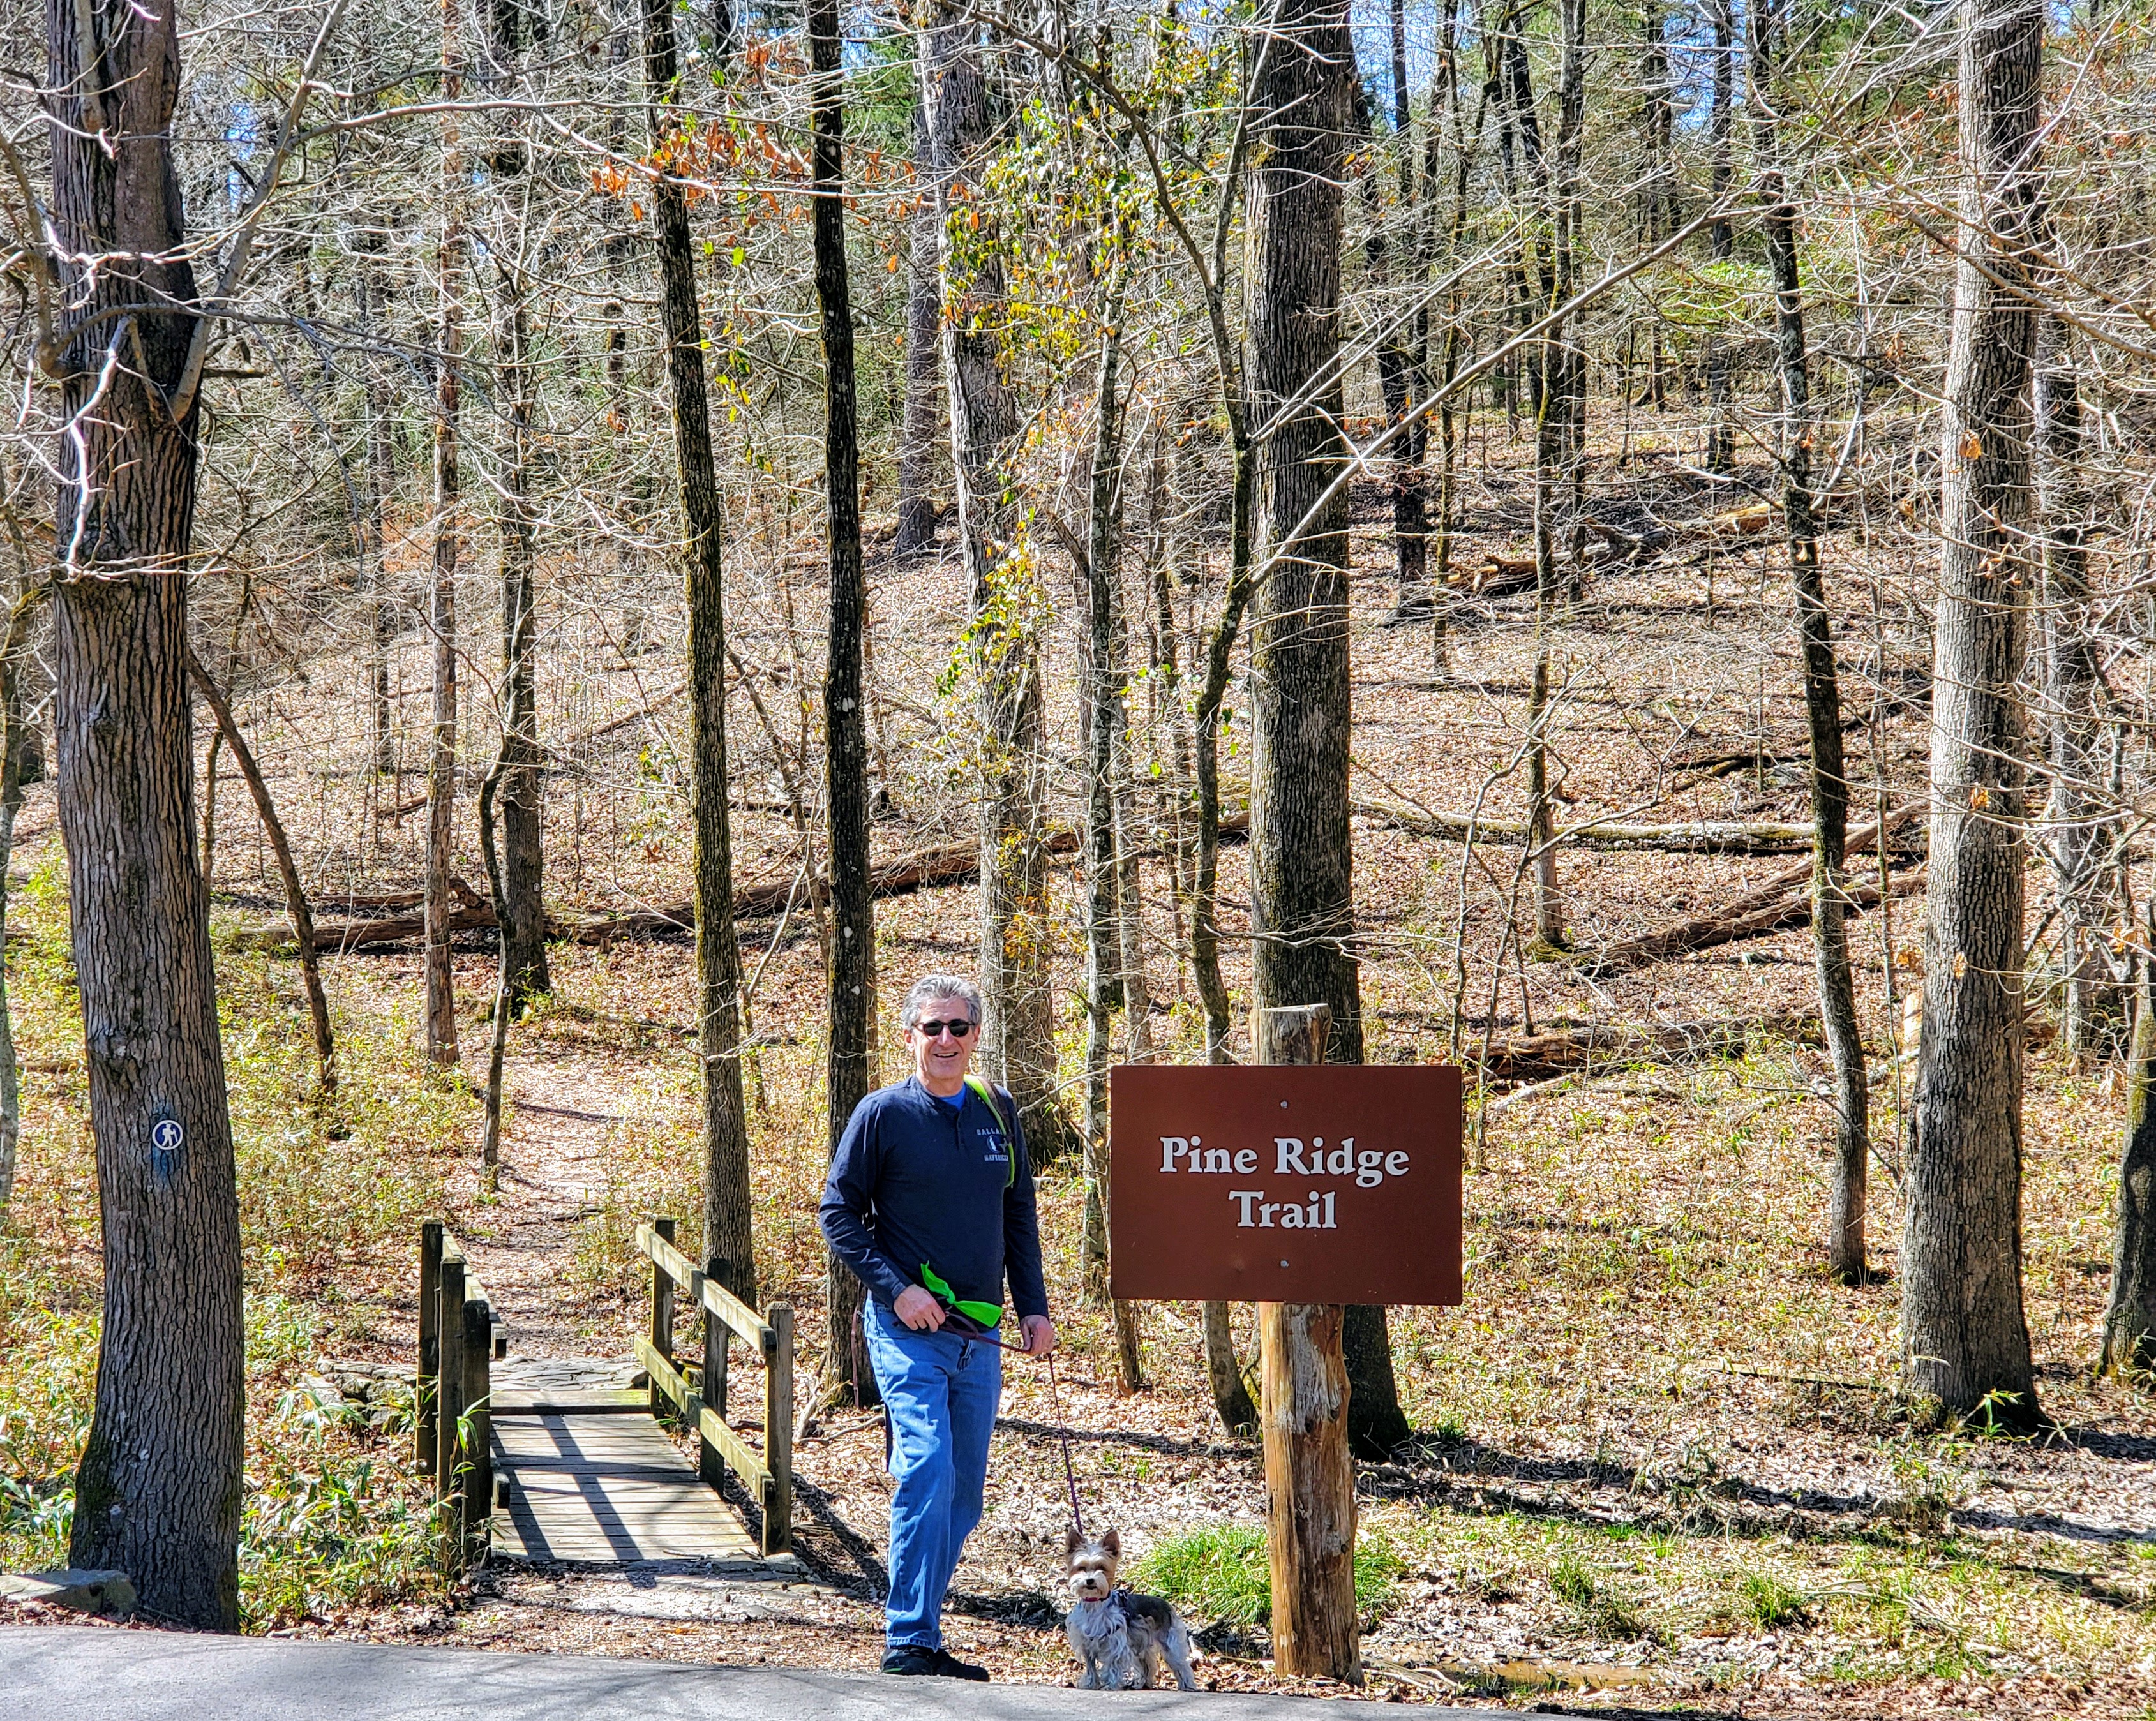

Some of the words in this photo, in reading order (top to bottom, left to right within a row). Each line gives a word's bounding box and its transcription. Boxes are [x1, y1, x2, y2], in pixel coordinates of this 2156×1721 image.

[976, 1128, 1003, 1136] DALLA
[1159, 1136, 1258, 1175] Pine
[1273, 1136, 1410, 1188] Ridge
[1228, 1189, 1338, 1229] Trail
